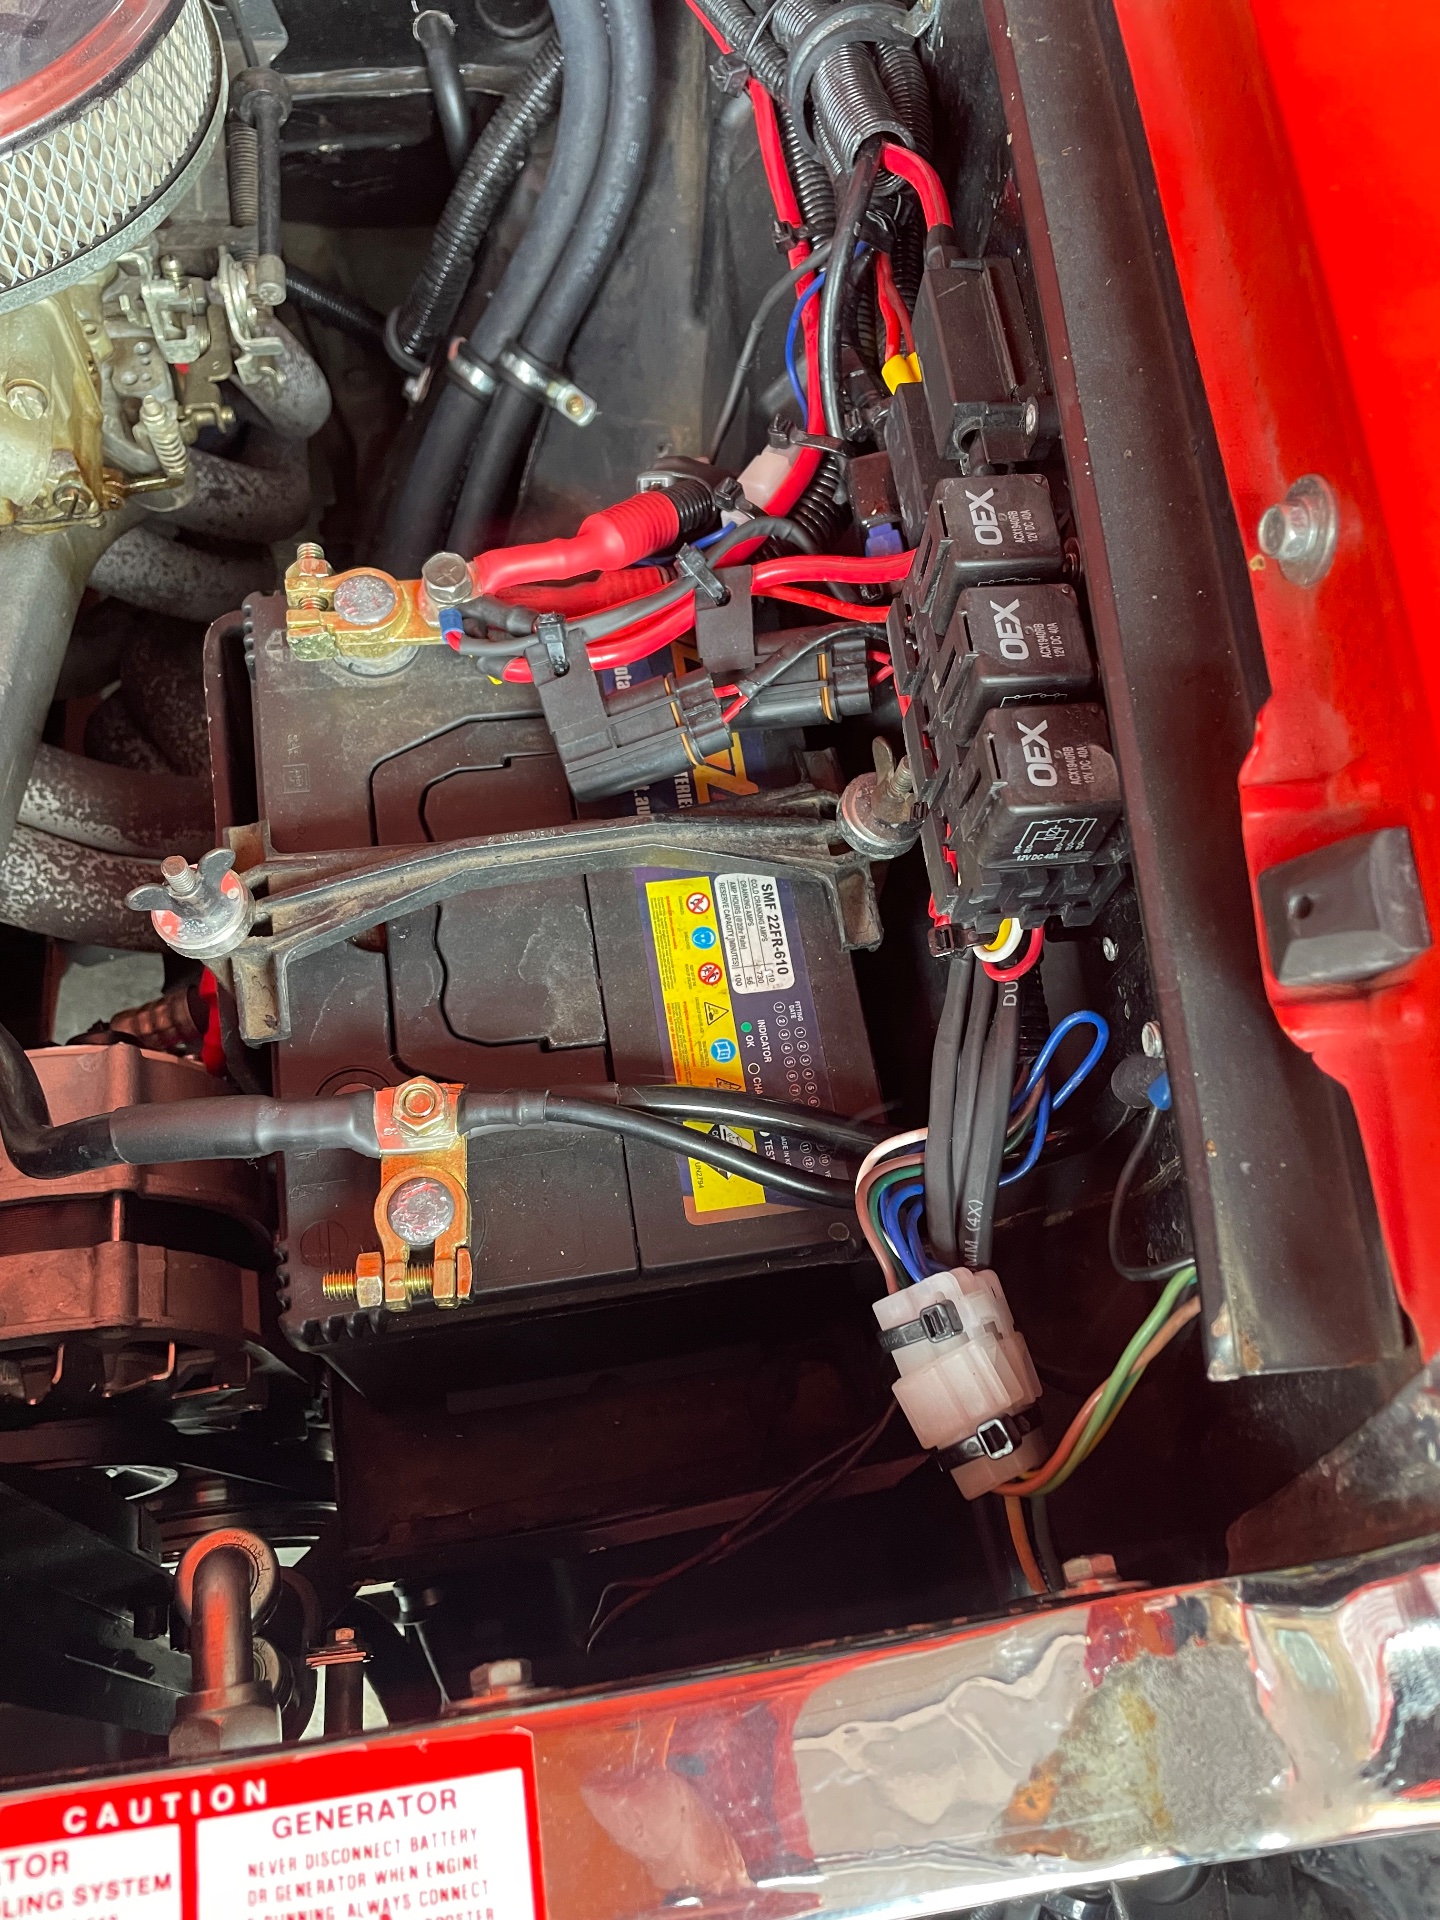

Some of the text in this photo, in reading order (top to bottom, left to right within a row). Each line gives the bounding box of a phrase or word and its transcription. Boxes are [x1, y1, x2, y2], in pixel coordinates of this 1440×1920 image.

[965, 487, 1003, 546] OEX
[1023, 521, 1035, 531] DC
[989, 598, 1029, 660] OEX
[1033, 623, 1052, 658] ACX1940RB
[1047, 622, 1066, 658] 12V DC 40A
[1017, 720, 1058, 787] OEX
[1062, 746, 1082, 785] ACX1940RB
[1076, 746, 1095, 784] 12V DC 40A
[674, 771, 693, 809] TERIE
[729, 881, 738, 894] AMP
[731, 894, 741, 915] HOURS
[751, 879, 760, 895] COLD
[761, 883, 777, 910] SMF
[753, 895, 766, 925] CRANKING
[718, 882, 730, 909] RESERVE
[734, 973, 743, 987] 100
[740, 880, 765, 984] CRANKING AMPS 730
[759, 926, 768, 942] AMPS
[767, 914, 789, 976] 22FR-610
[746, 976, 754, 986] 56
[1002, 981, 1019, 1007] DU
[789, 1005, 797, 1019] DATE
[746, 1035, 755, 1048] OK
[757, 1020, 773, 1062] INDICATOR
[965, 1200, 984, 1231] (4X)
[62, 1778, 268, 1834] CAUTION
[272, 1788, 458, 1839] GENERATOR
[0, 1850, 70, 1884] TOR
[247, 1827, 478, 1879] NEVER DISCONNECT BATTERY
[72, 1872, 173, 1907] SYSTEM
[275, 1872, 366, 1903] GENERATOR
[374, 1865, 419, 1885] WHEN
[426, 1853, 479, 1879] ENGINE
[419, 1879, 488, 1907] CONNECT
